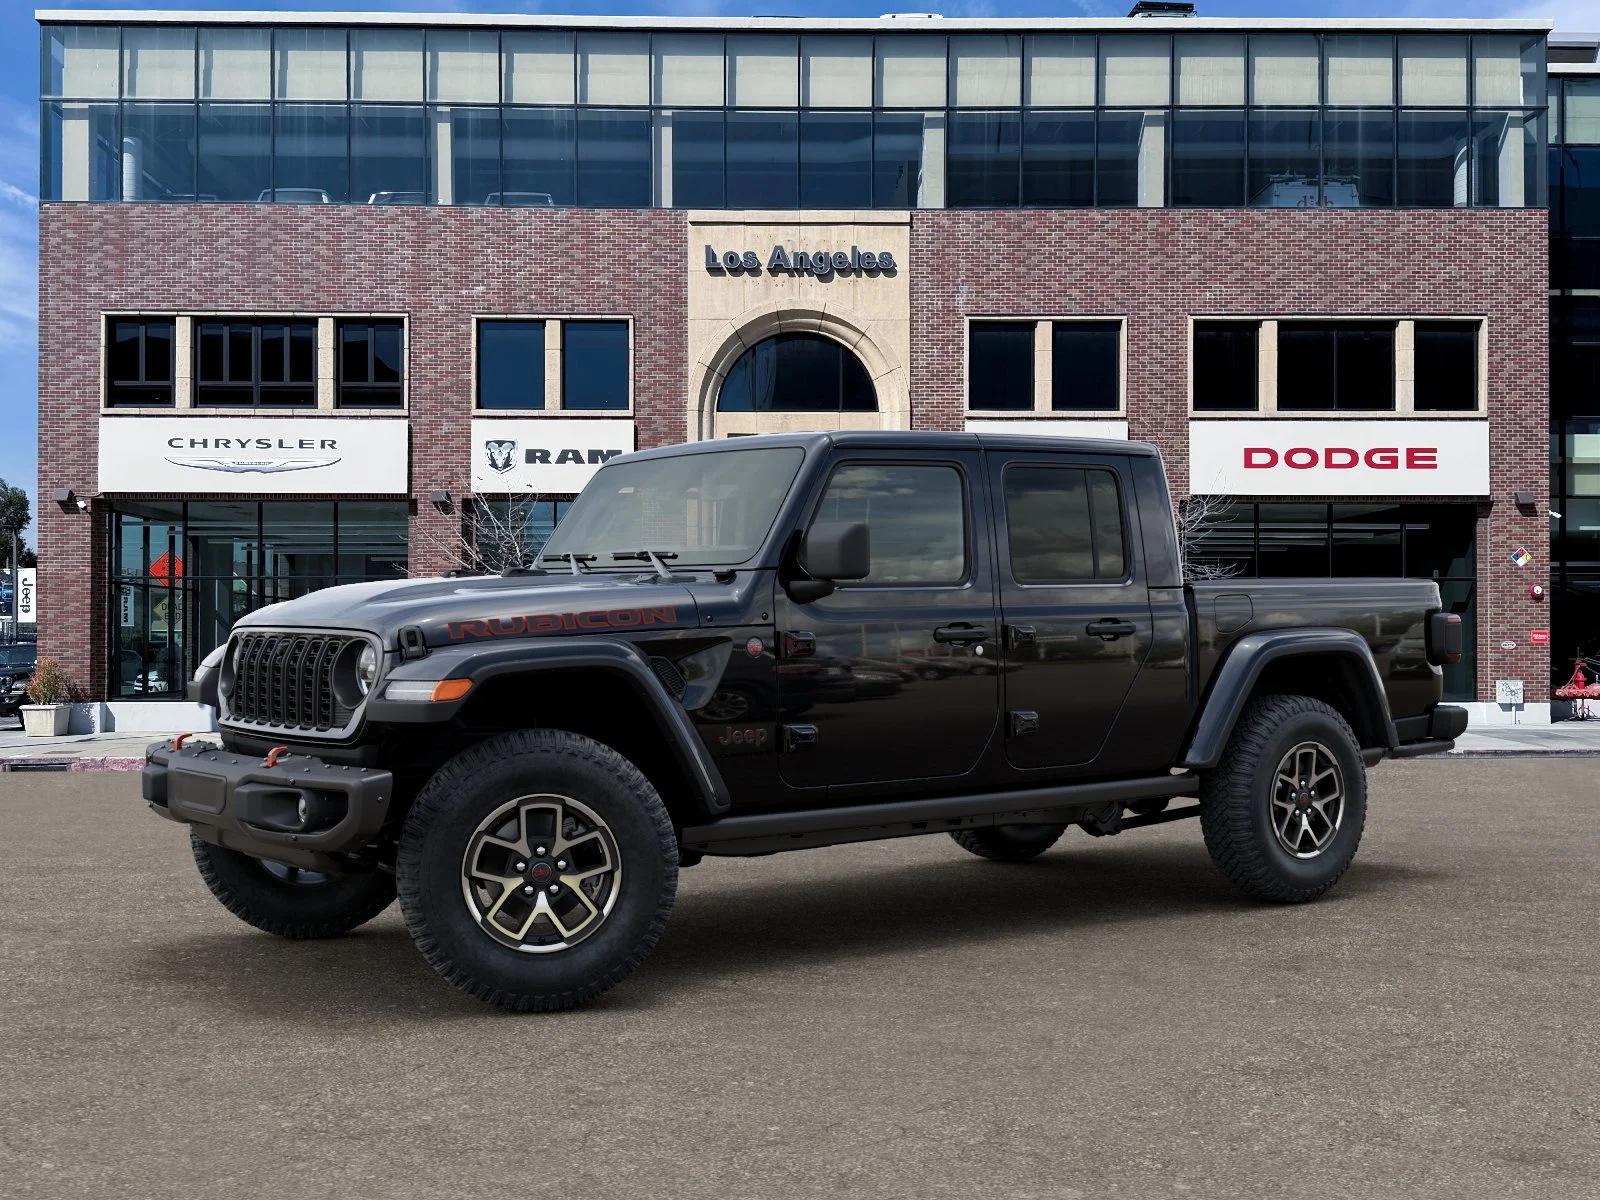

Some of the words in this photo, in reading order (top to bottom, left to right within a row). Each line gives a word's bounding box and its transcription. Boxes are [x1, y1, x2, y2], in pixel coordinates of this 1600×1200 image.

[704, 244, 761, 270] Los
[767, 244, 896, 275] Angeles
[167, 437, 338, 450] CHRYSLER
[524, 448, 623, 465] RAM
[1243, 447, 1438, 470] DODGE
[20, 577, 33, 614] Jeep
[164, 612, 181, 620] ED
[447, 605, 678, 640] RUBICON
[718, 726, 768, 747] Jeep
